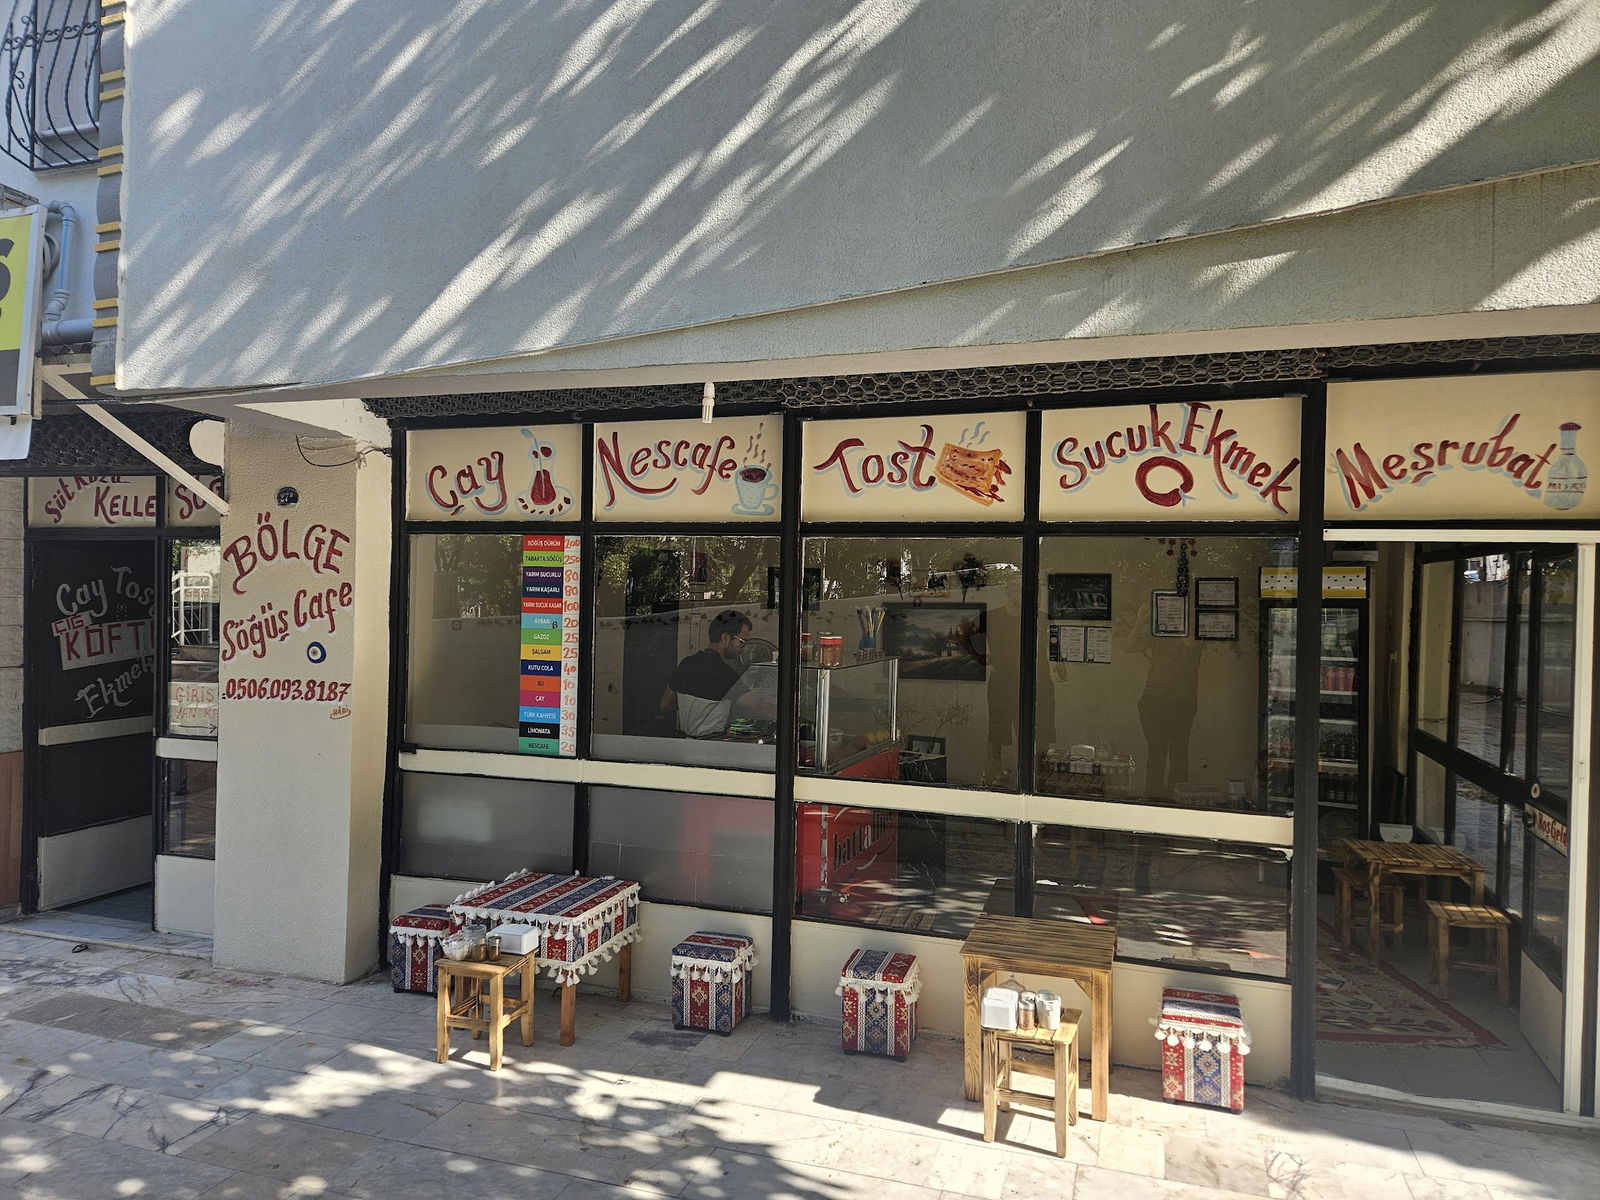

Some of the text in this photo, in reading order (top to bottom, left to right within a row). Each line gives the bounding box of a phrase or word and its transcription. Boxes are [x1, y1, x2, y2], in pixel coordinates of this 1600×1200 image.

[813, 424, 936, 494] Tost
[1056, 402, 1301, 514] Sucuk Ekmek
[1336, 413, 1557, 509] Meşrubat
[598, 432, 738, 507] Nescafe
[428, 451, 505, 516] Çay
[223, 511, 350, 595] BÖLGE
[564, 569, 579, 582] 80
[564, 585, 579, 597] 80
[563, 600, 579, 612] 100
[221, 582, 353, 662] Söğüş Cafe
[564, 617, 579, 629] 20
[65, 621, 155, 661] KÖFT
[564, 632, 579, 644] 25
[562, 647, 578, 659] 25
[564, 662, 577, 676] 40
[562, 678, 576, 691] 10
[561, 709, 576, 721] 30
[560, 724, 575, 738] 35
